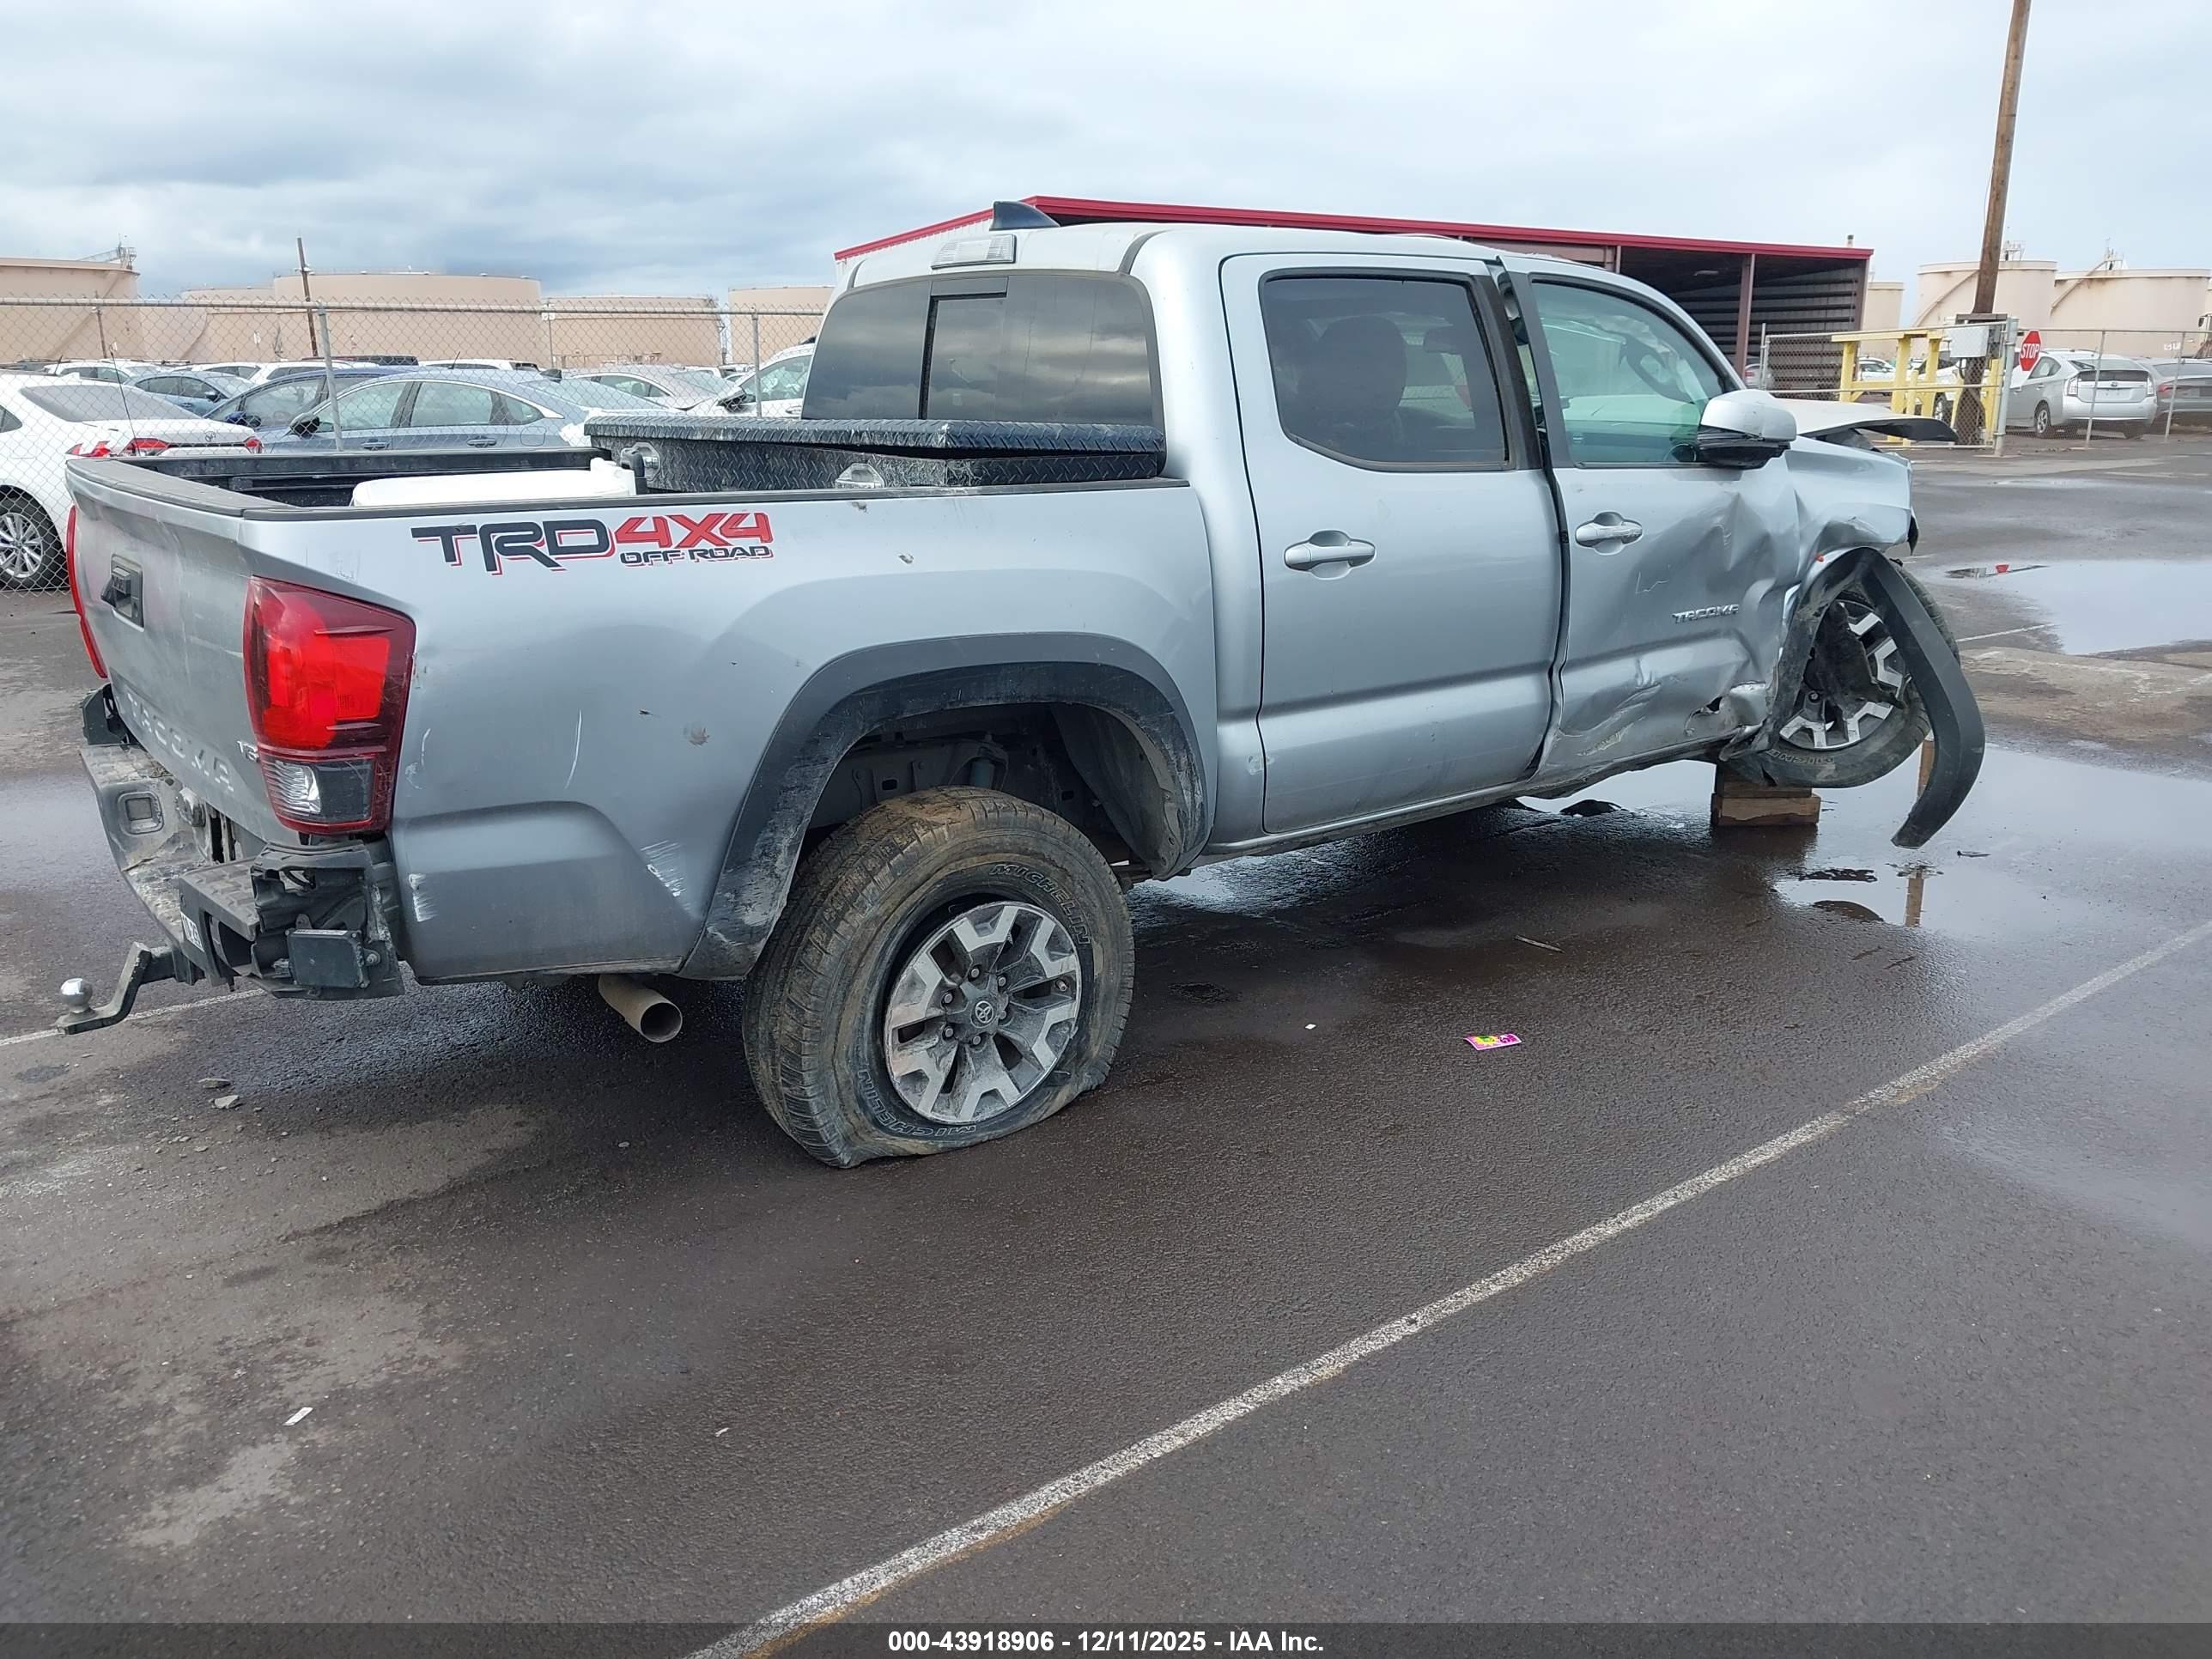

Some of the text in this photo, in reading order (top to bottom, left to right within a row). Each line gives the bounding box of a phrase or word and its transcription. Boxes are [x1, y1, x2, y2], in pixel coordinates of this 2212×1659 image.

[2021, 343, 2040, 359] STOP
[410, 513, 772, 575] TRD 4X4
[620, 545, 774, 567] OFF ROAD
[988, 863, 1091, 945] MICHELIN
[858, 1071, 976, 1138] MICHELIN
